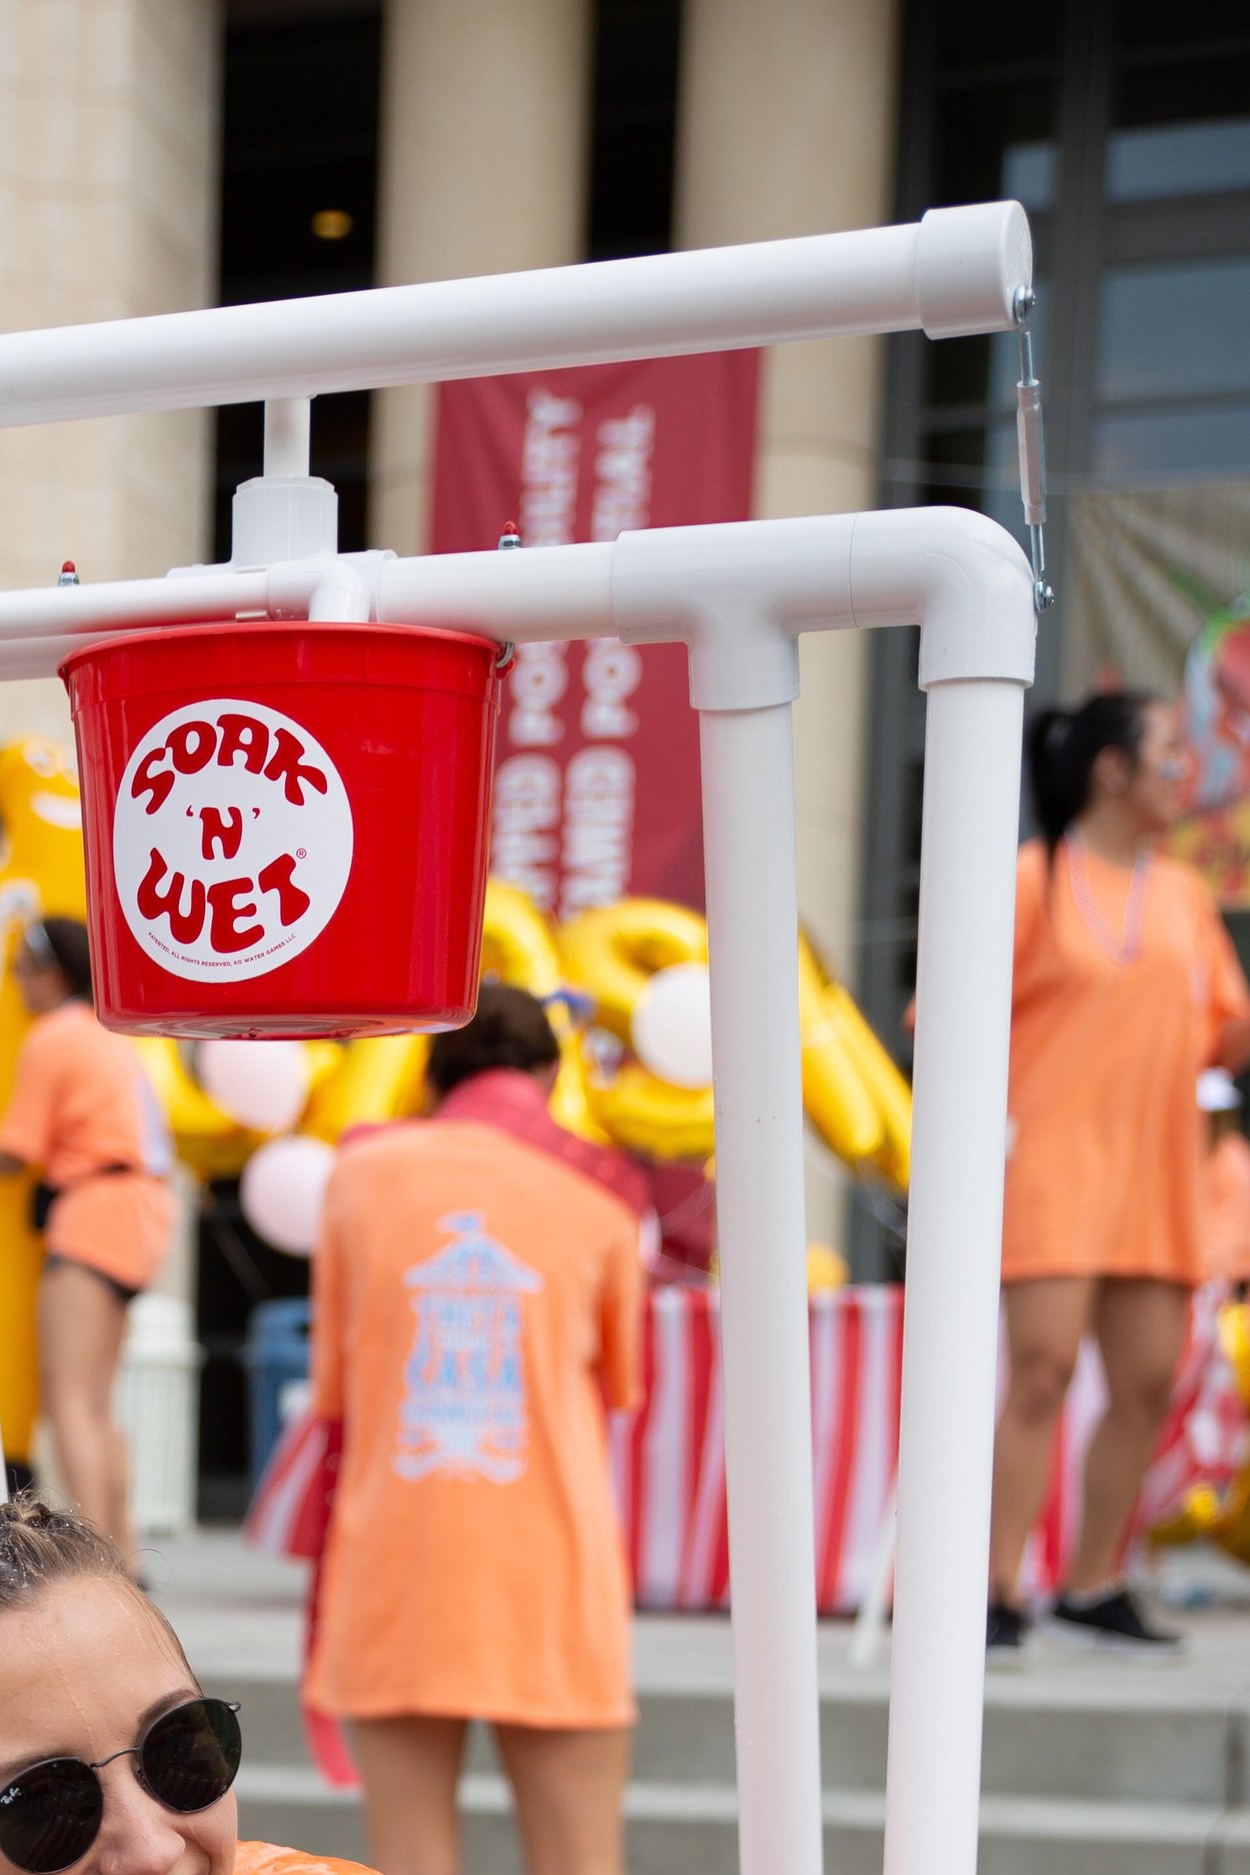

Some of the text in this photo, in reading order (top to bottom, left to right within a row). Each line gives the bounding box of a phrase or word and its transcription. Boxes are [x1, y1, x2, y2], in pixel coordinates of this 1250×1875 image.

[131, 714, 328, 815] SOAK
[148, 932, 170, 955] PATENTED,
[171, 951, 180, 959] ALL
[181, 955, 200, 966] RIGHTS
[201, 960, 233, 968] RESERVED,
[244, 952, 265, 964] WATER
[266, 941, 286, 956] GAMES
[286, 933, 297, 944] LLC
